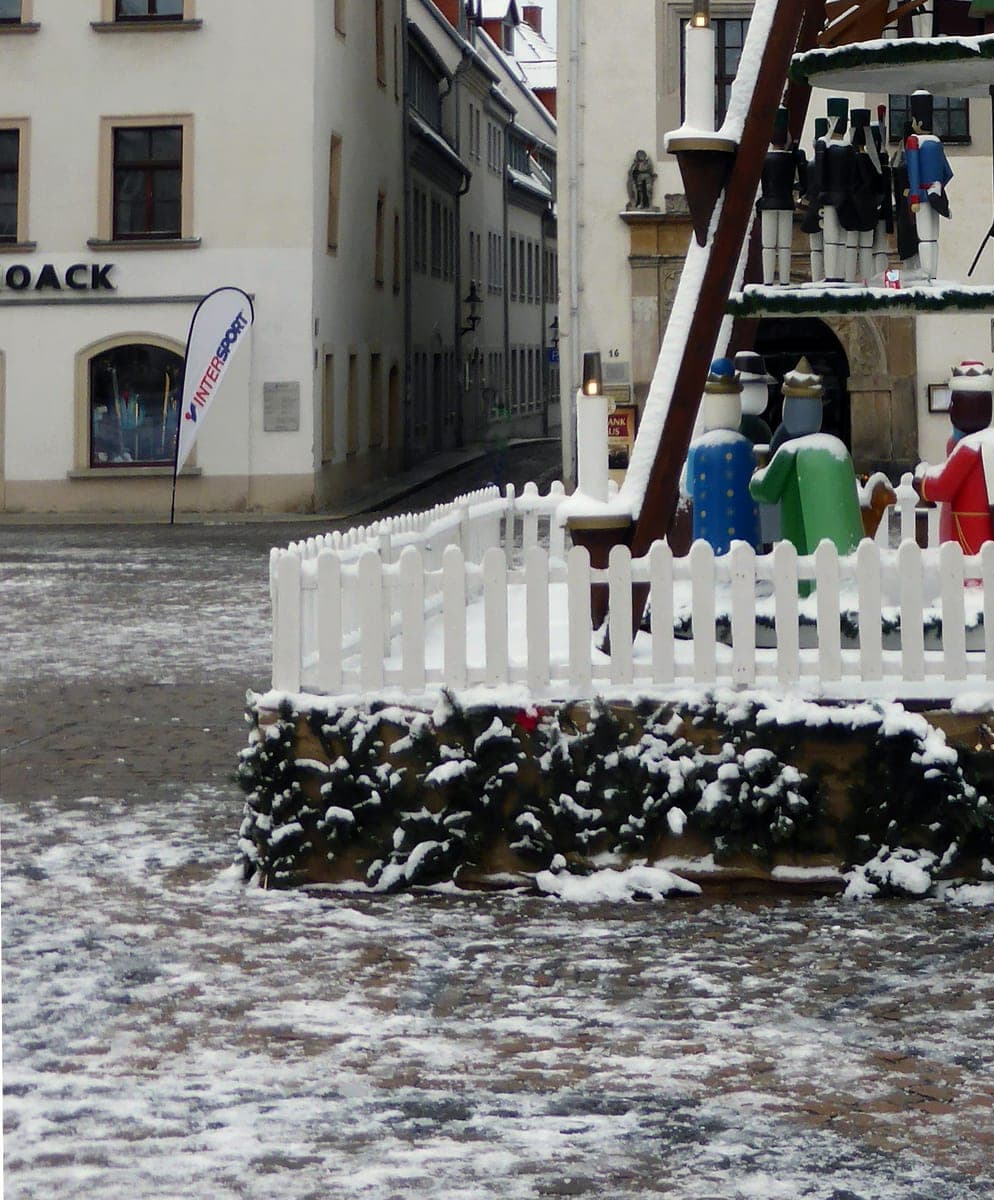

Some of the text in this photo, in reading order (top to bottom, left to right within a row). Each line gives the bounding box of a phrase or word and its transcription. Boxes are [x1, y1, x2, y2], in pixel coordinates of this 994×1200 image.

[5, 263, 115, 290] OACK
[193, 311, 248, 407] INTERSPORT
[609, 349, 619, 357] 16
[608, 418, 626, 426] ANK
